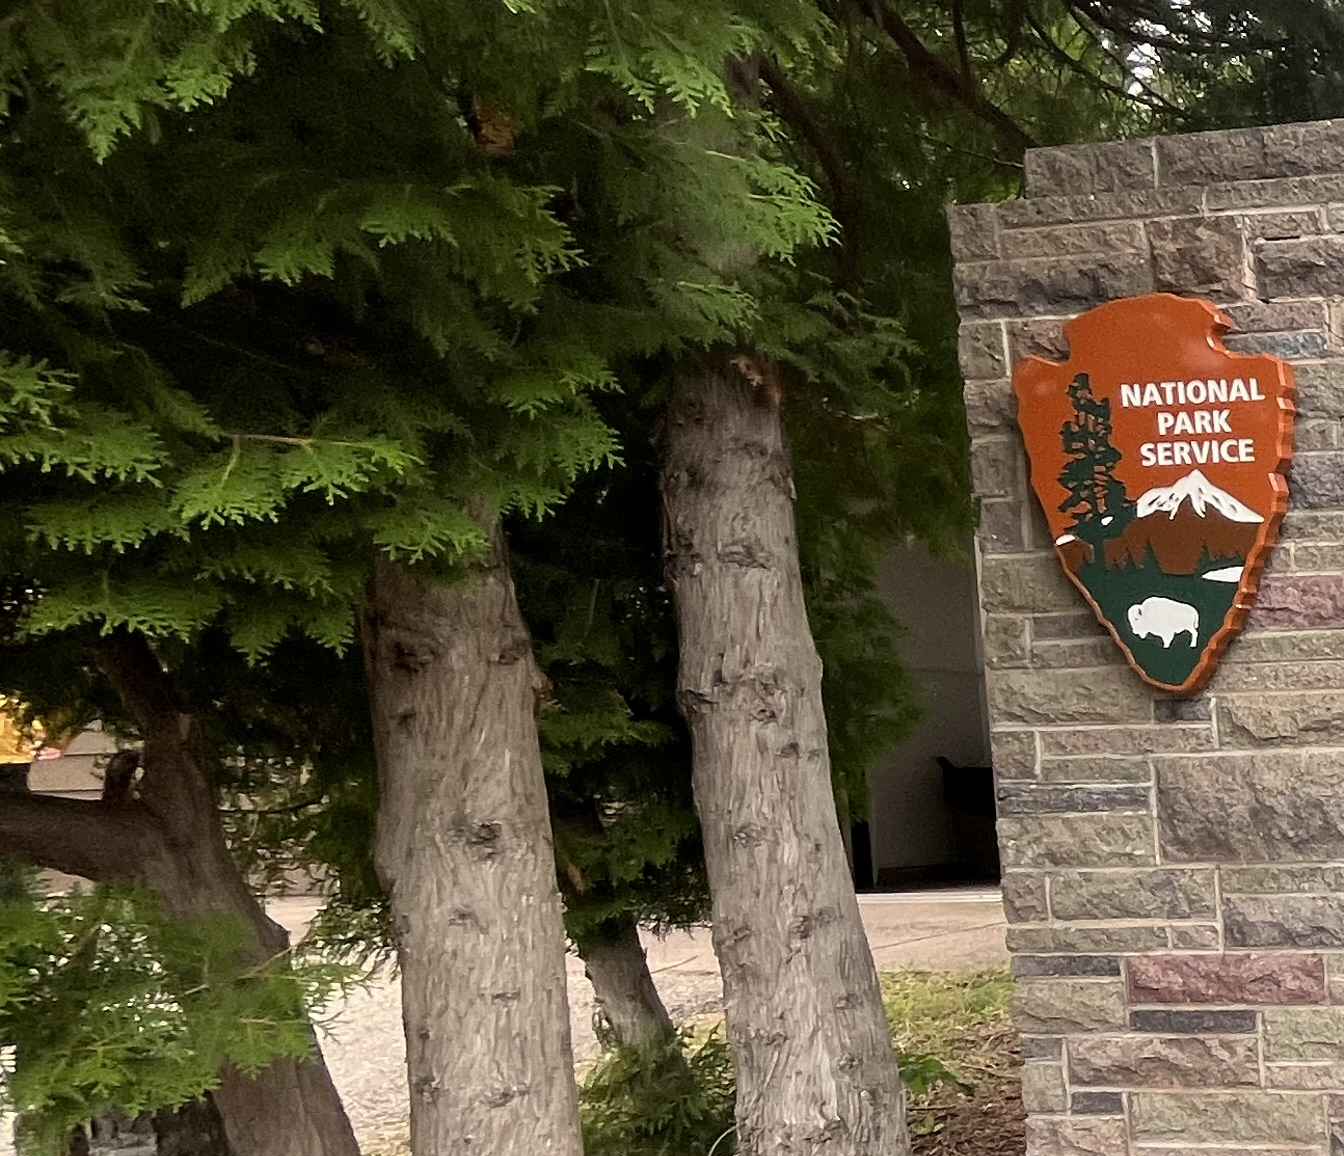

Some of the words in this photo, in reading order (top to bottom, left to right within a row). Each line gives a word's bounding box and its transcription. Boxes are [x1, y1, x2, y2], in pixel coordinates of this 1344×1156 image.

[1120, 378, 1266, 407] NATIONAL
[1157, 409, 1232, 436] PARK
[1139, 438, 1256, 467] SERVICE
